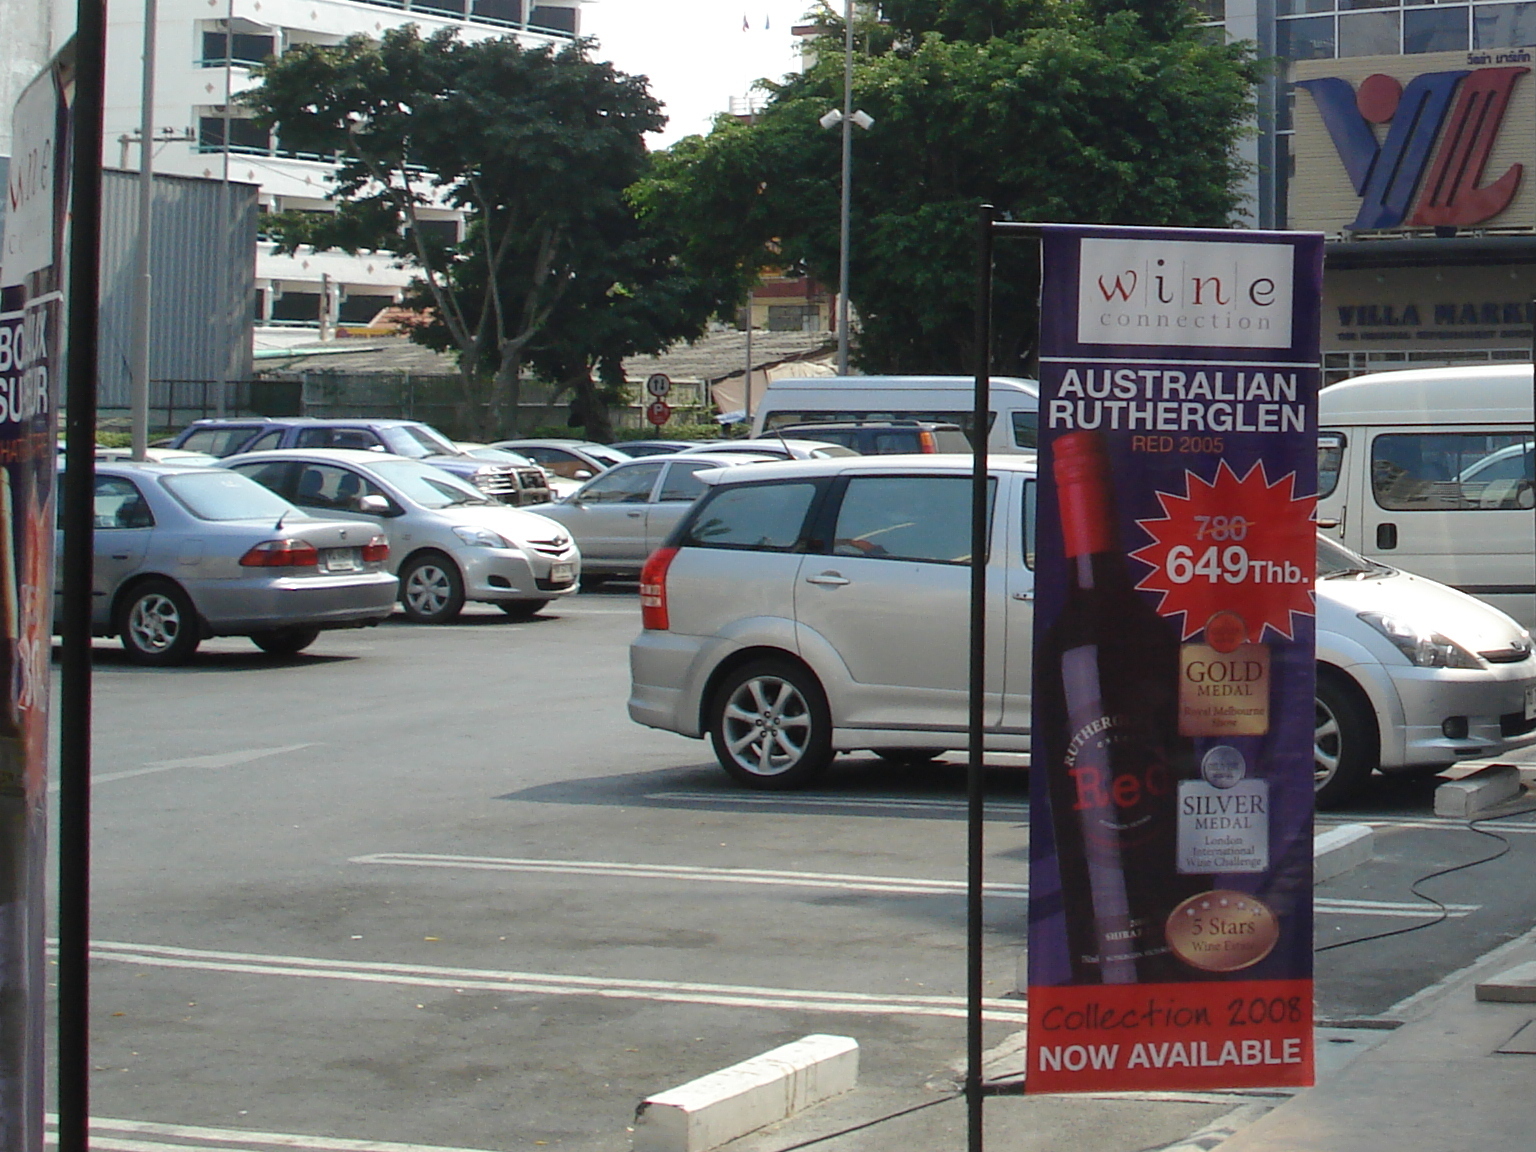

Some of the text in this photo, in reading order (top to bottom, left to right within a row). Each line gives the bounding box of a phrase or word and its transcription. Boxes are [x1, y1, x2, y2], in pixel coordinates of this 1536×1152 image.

[1098, 259, 1275, 308] wine
[1099, 311, 1271, 331] connection
[1338, 305, 1421, 326] VILLA
[1057, 368, 1298, 402] AUSTRALIAN
[1048, 400, 1306, 433] RUTHERGLEN
[1132, 436, 1224, 453] RED 2005
[1194, 516, 1247, 542] 780
[1186, 661, 1262, 682] GOLD
[1198, 684, 1252, 696] MEDAL
[1183, 795, 1266, 815] SILVER
[1195, 817, 1252, 830] MEDAL
[1205, 835, 1243, 846] London
[1214, 856, 1262, 868] Challenge
[1191, 917, 1256, 936] 5 Stars
[1041, 997, 1302, 1033] Collection 2008
[1039, 1038, 1303, 1073] NOW AVAILABLE
